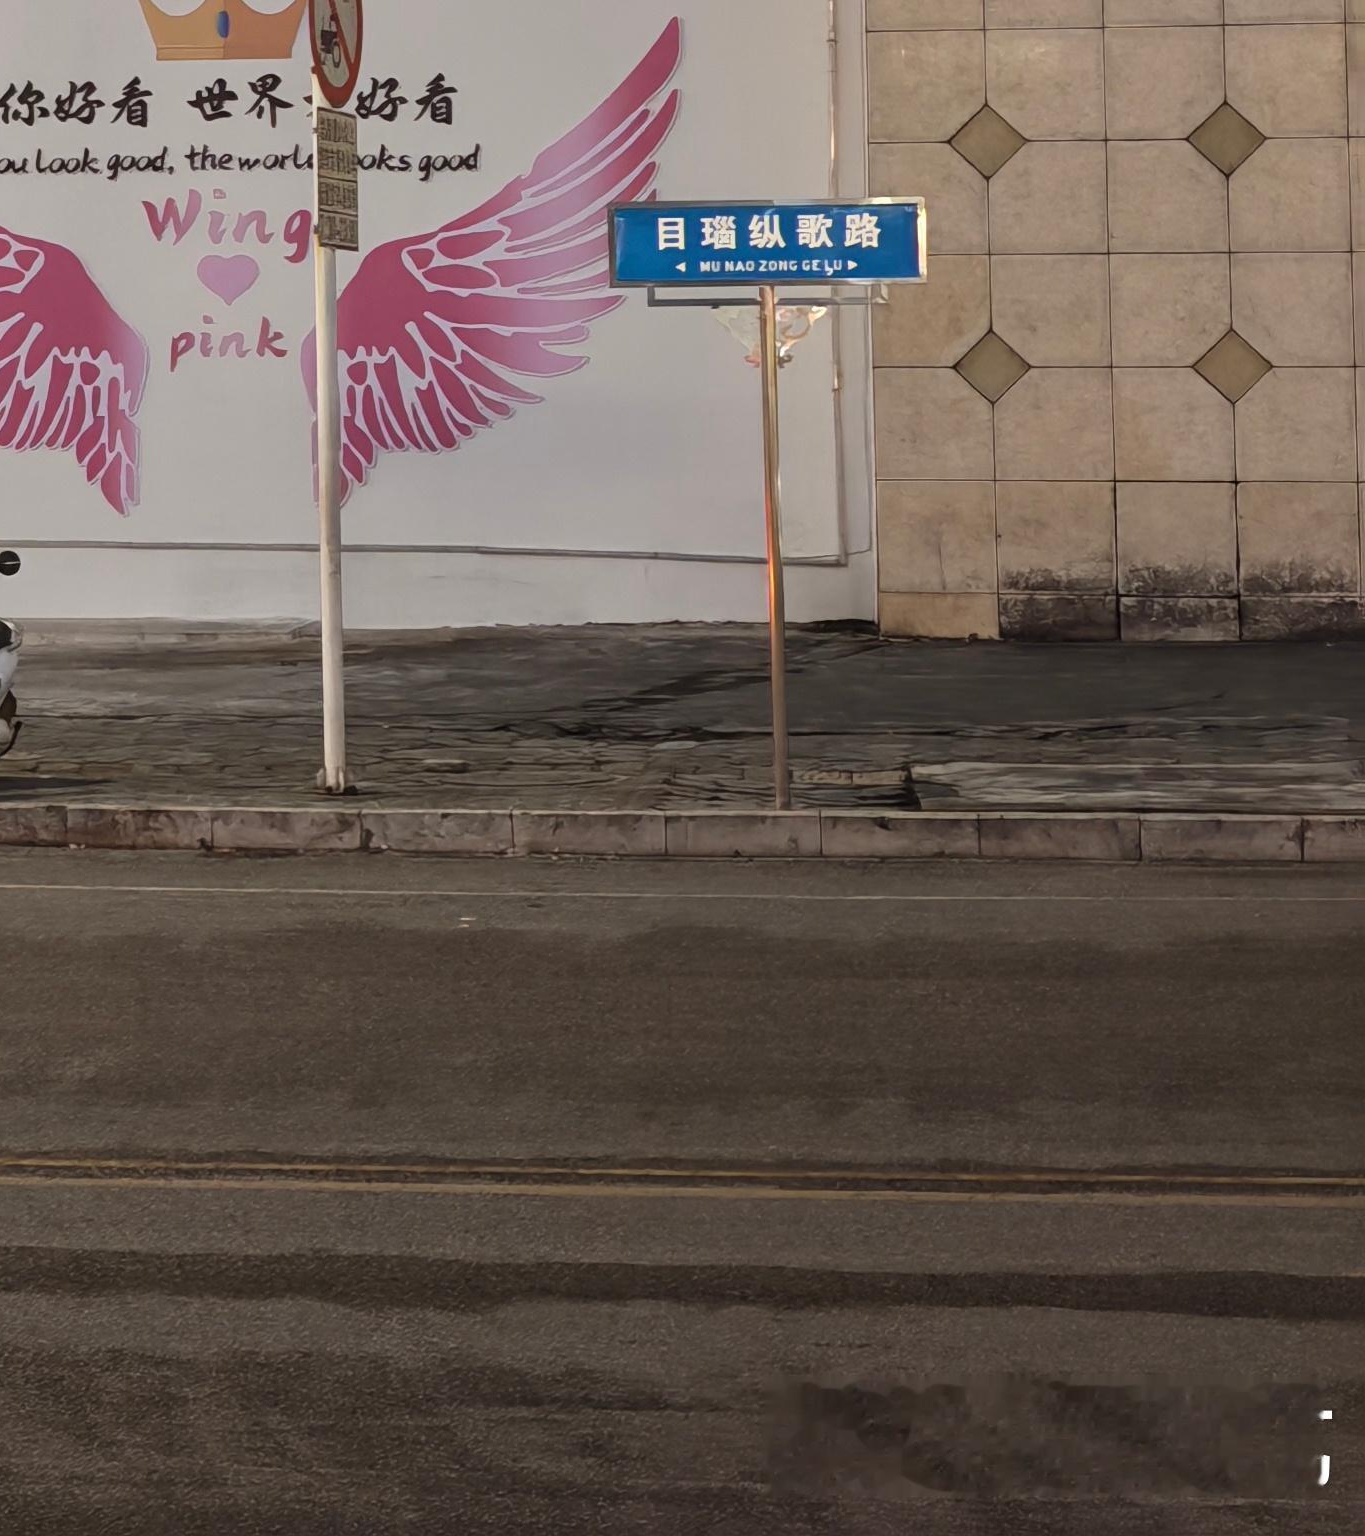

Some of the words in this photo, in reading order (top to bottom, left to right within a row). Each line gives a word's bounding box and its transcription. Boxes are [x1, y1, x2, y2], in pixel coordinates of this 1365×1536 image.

[186, 72, 459, 128] 世界好看
[35, 147, 102, 174] look
[184, 144, 234, 172] the
[418, 143, 481, 182] good
[657, 212, 882, 251] 目瑙纵歌路
[169, 315, 287, 372] pink
